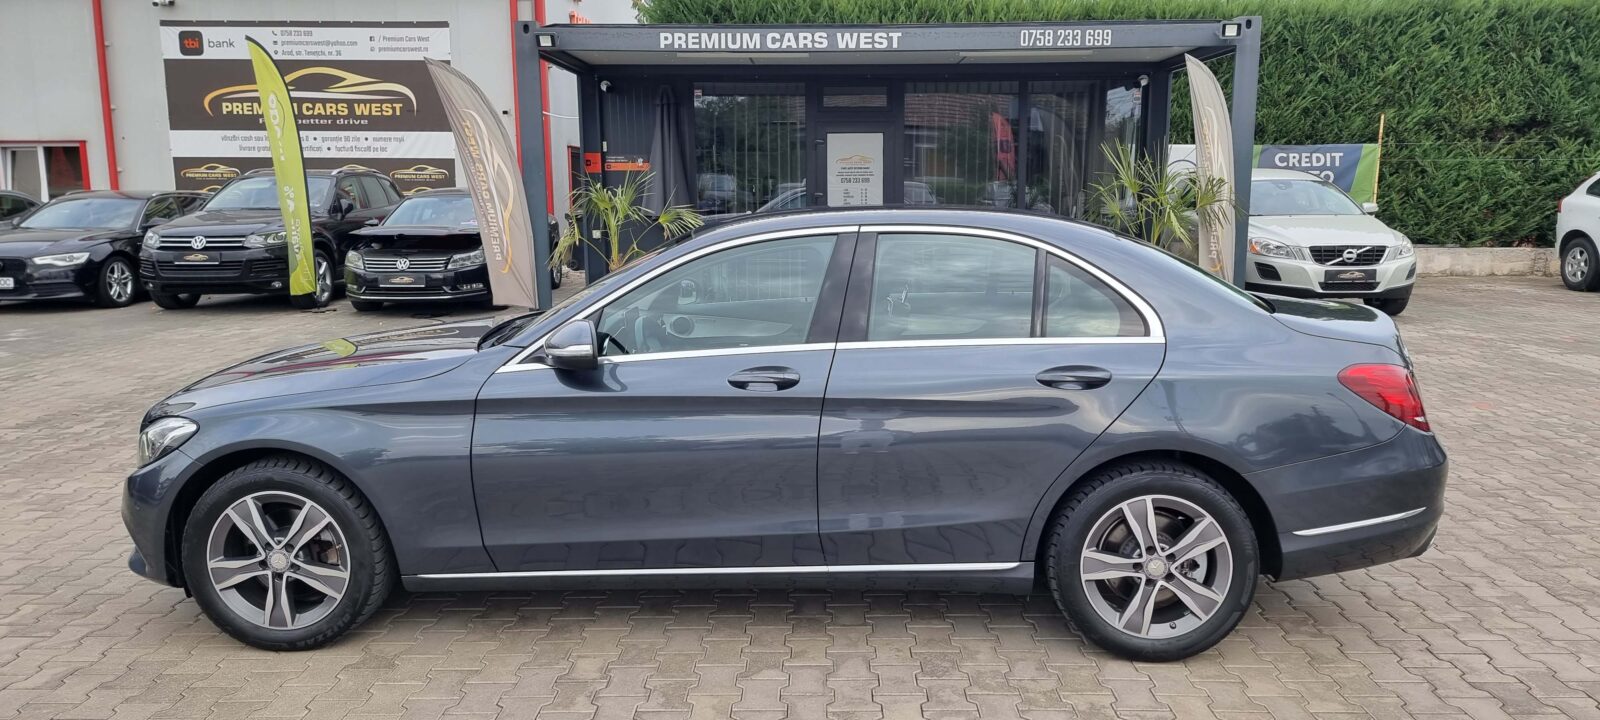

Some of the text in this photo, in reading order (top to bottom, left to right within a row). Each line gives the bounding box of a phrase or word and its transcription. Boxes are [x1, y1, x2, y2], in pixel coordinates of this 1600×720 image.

[184, 38, 236, 48] tbi bank
[659, 32, 902, 49] PREMIUM CARS WEST
[1020, 30, 1112, 46] 0758 233 699
[302, 102, 348, 115] CARS
[354, 103, 403, 116] WEST
[1274, 152, 1344, 167] CREDIT
